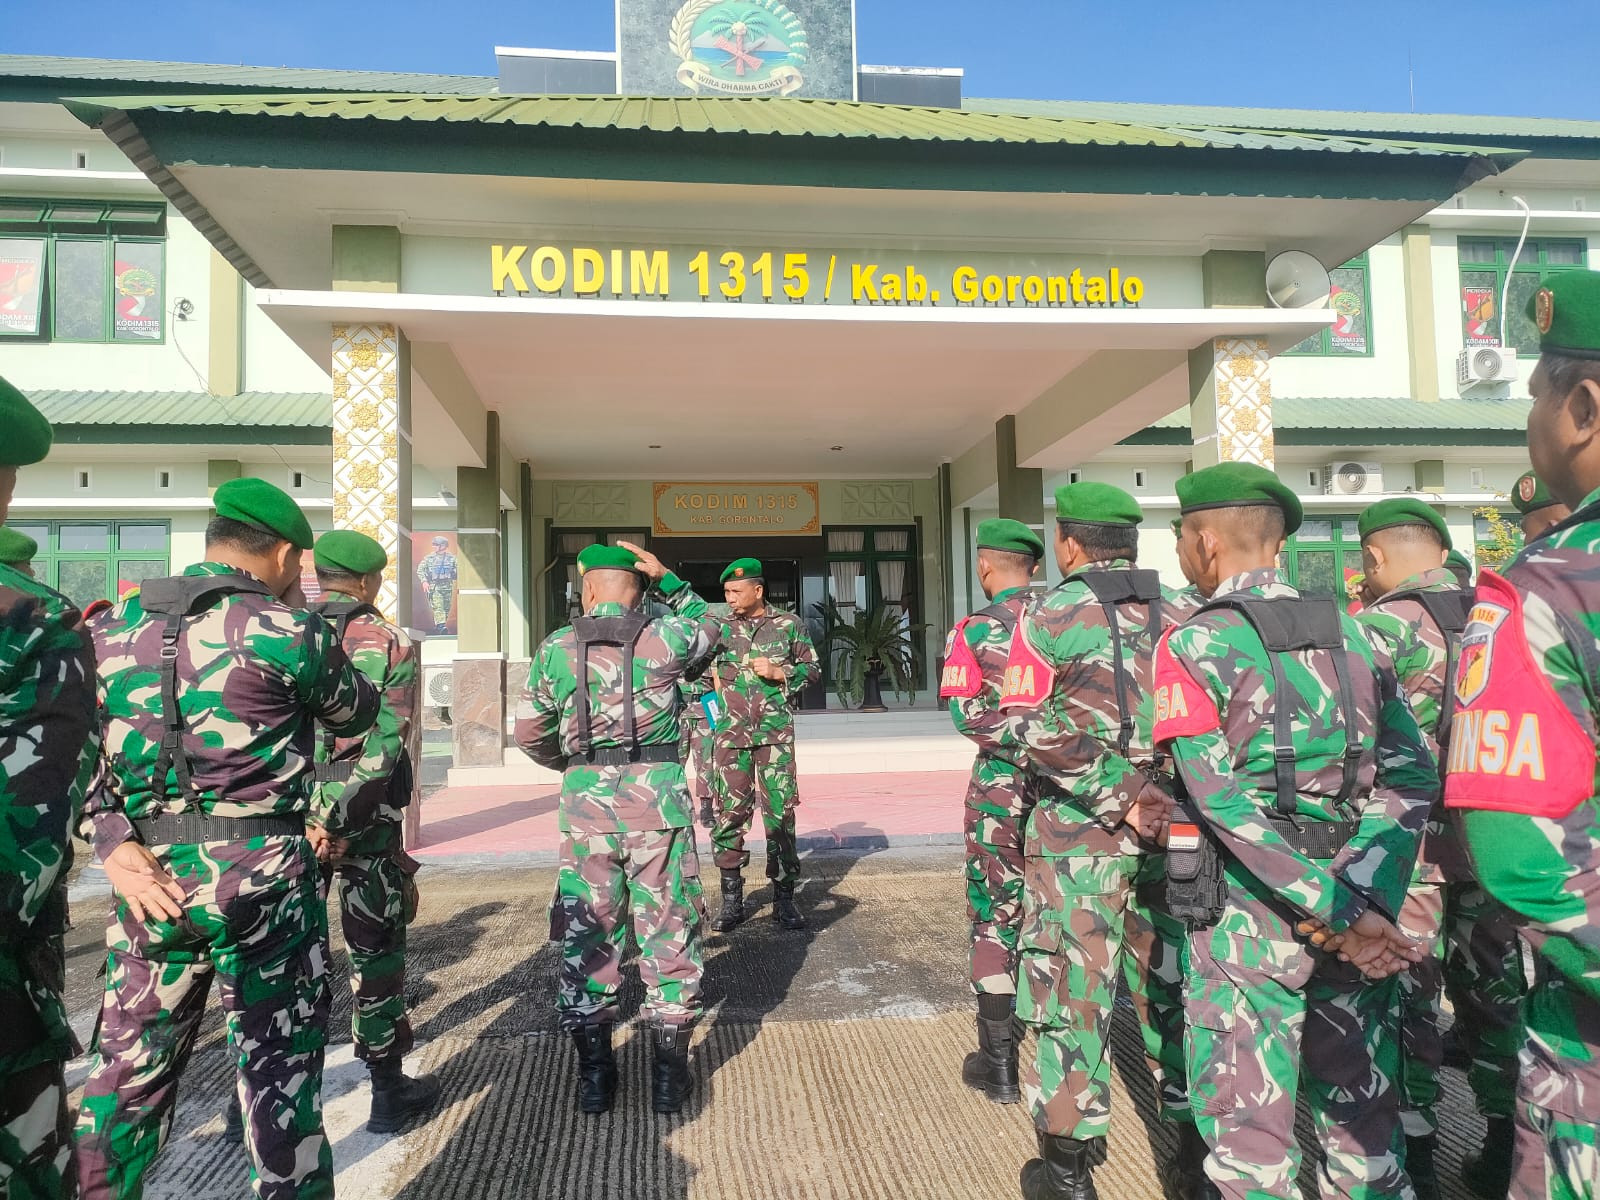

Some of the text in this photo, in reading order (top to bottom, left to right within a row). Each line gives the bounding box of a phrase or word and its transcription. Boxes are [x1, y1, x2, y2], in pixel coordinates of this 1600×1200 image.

[698, 74, 783, 91] WIRA DHARMA CAKTI
[491, 245, 1144, 303] KODIM 1315 / Kab. Gorontalo
[674, 494, 798, 509] KODIM 1315
[690, 515, 784, 524] KAB GORONTALO
